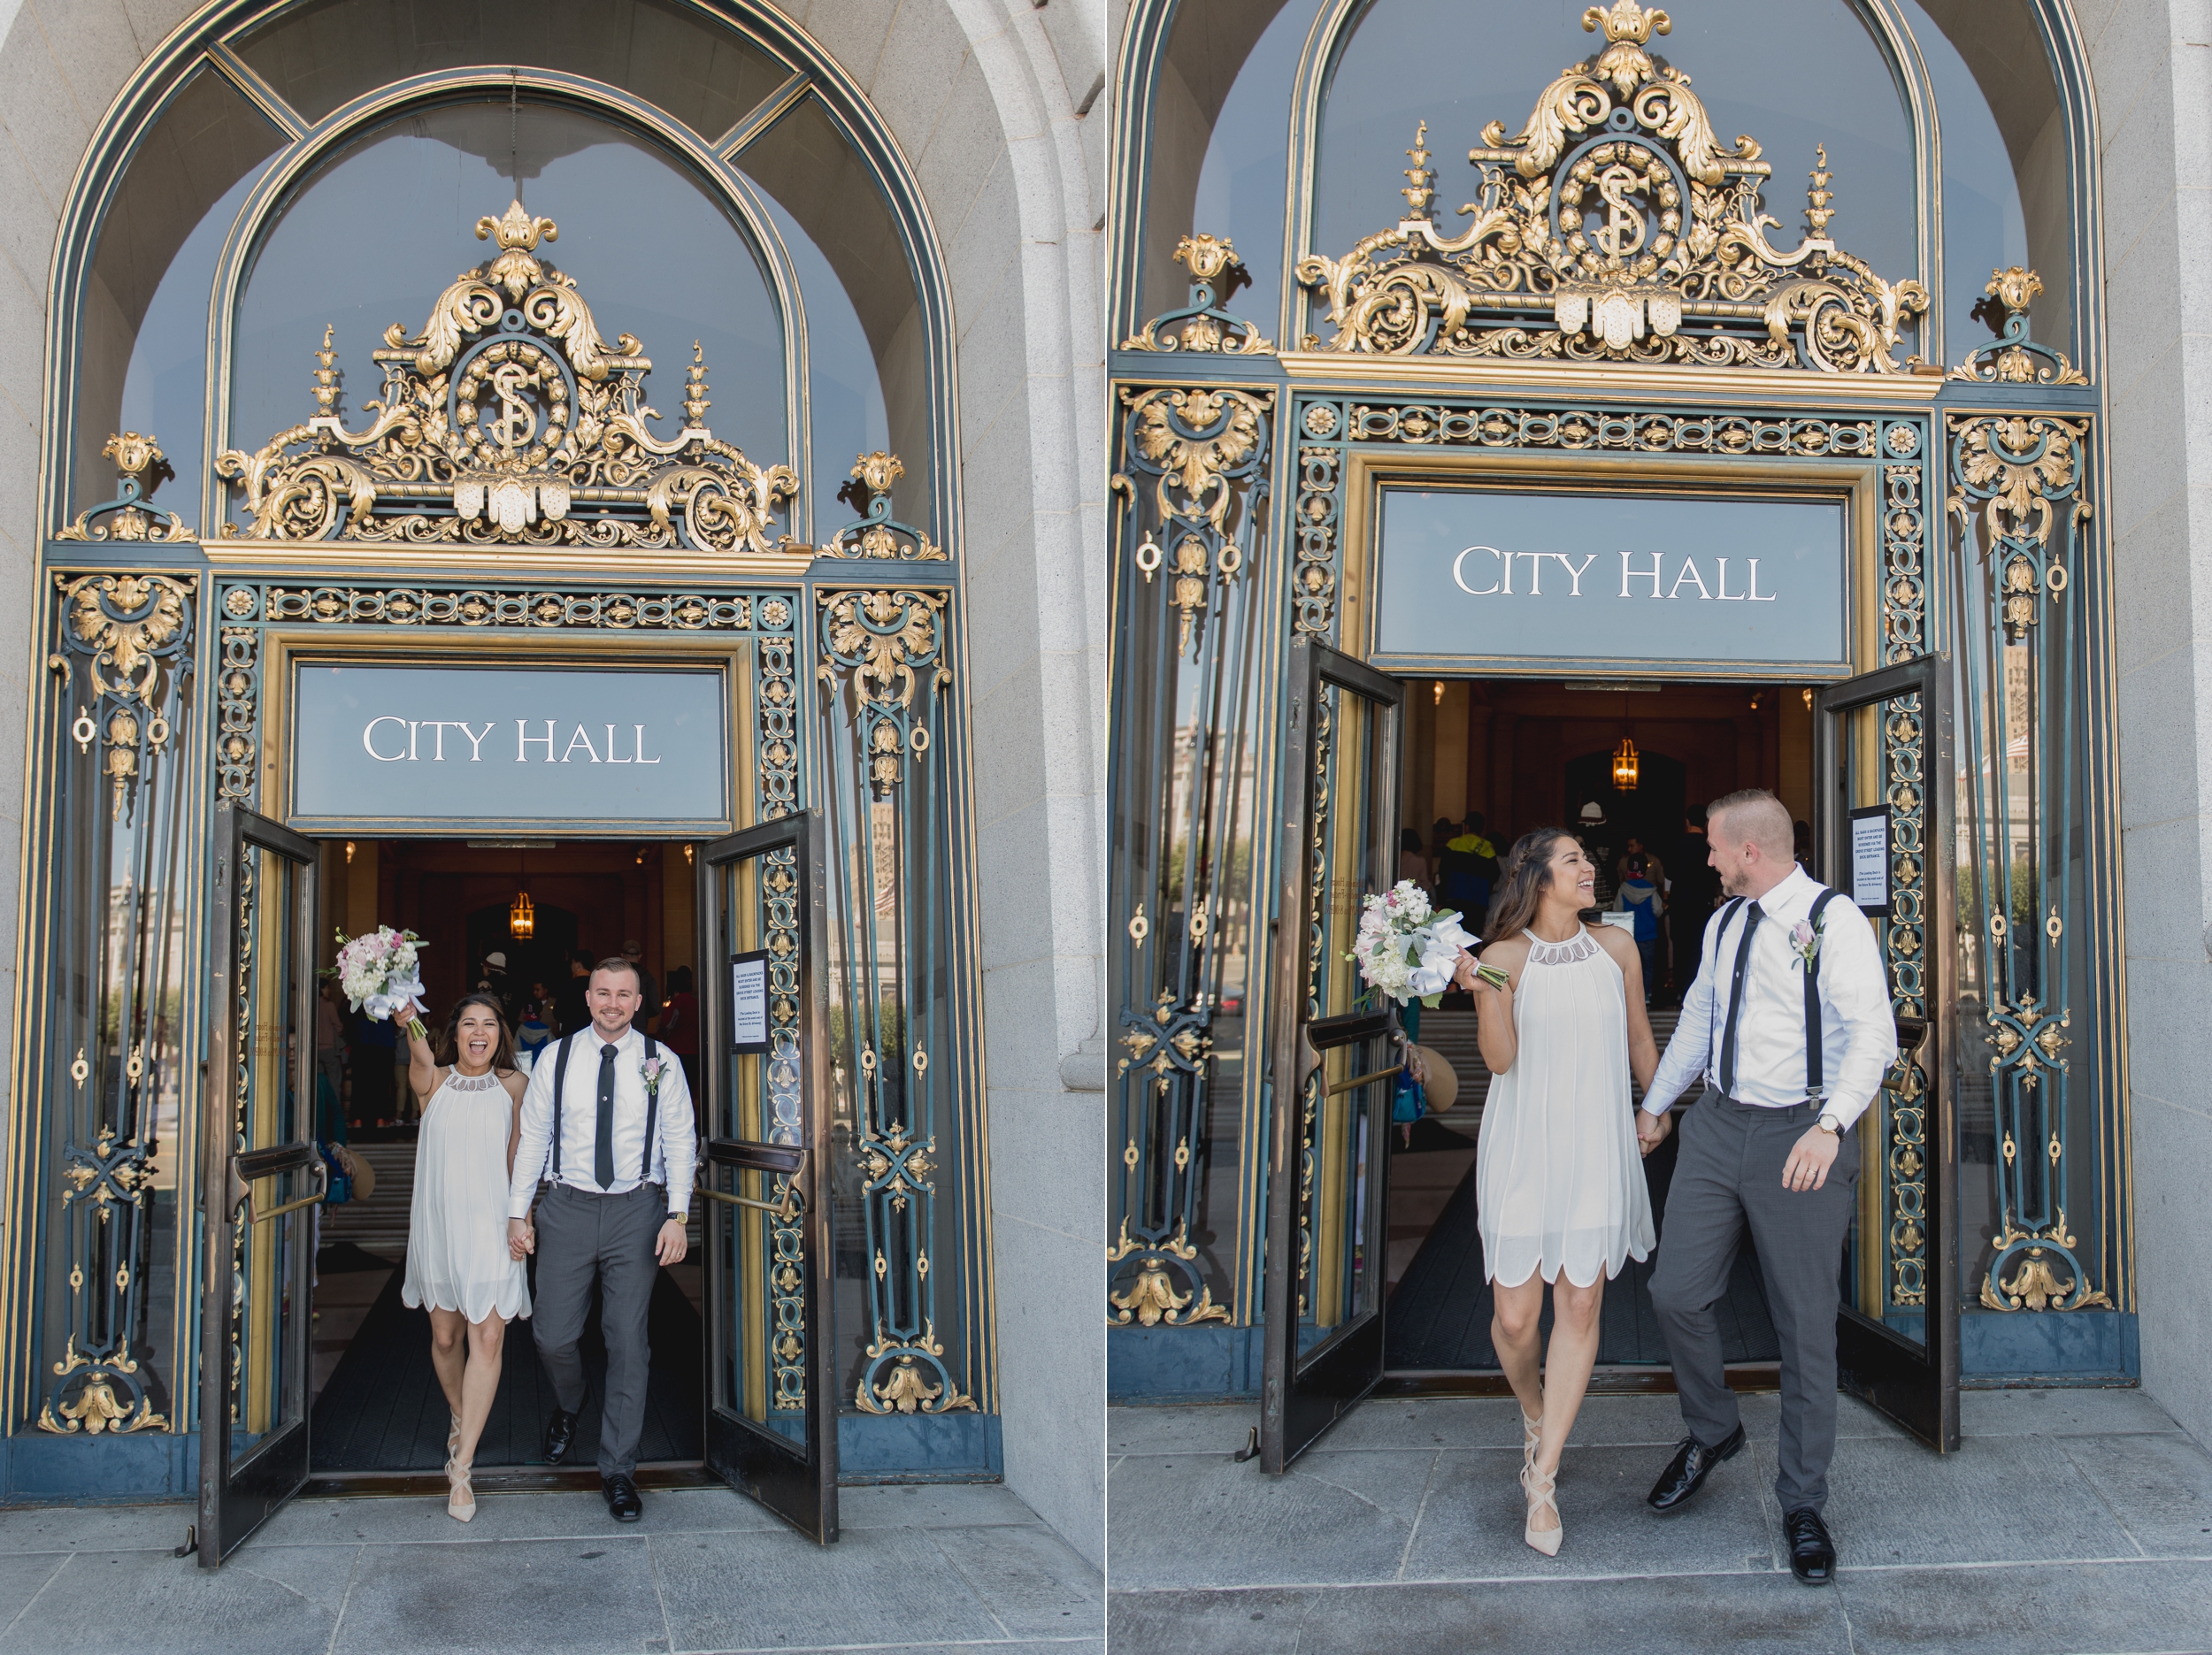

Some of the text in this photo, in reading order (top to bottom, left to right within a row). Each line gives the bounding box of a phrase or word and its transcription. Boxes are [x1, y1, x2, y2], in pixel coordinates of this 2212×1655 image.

[1452, 545, 1778, 601] CITY HALL
[363, 716, 662, 764] CITY HALL
